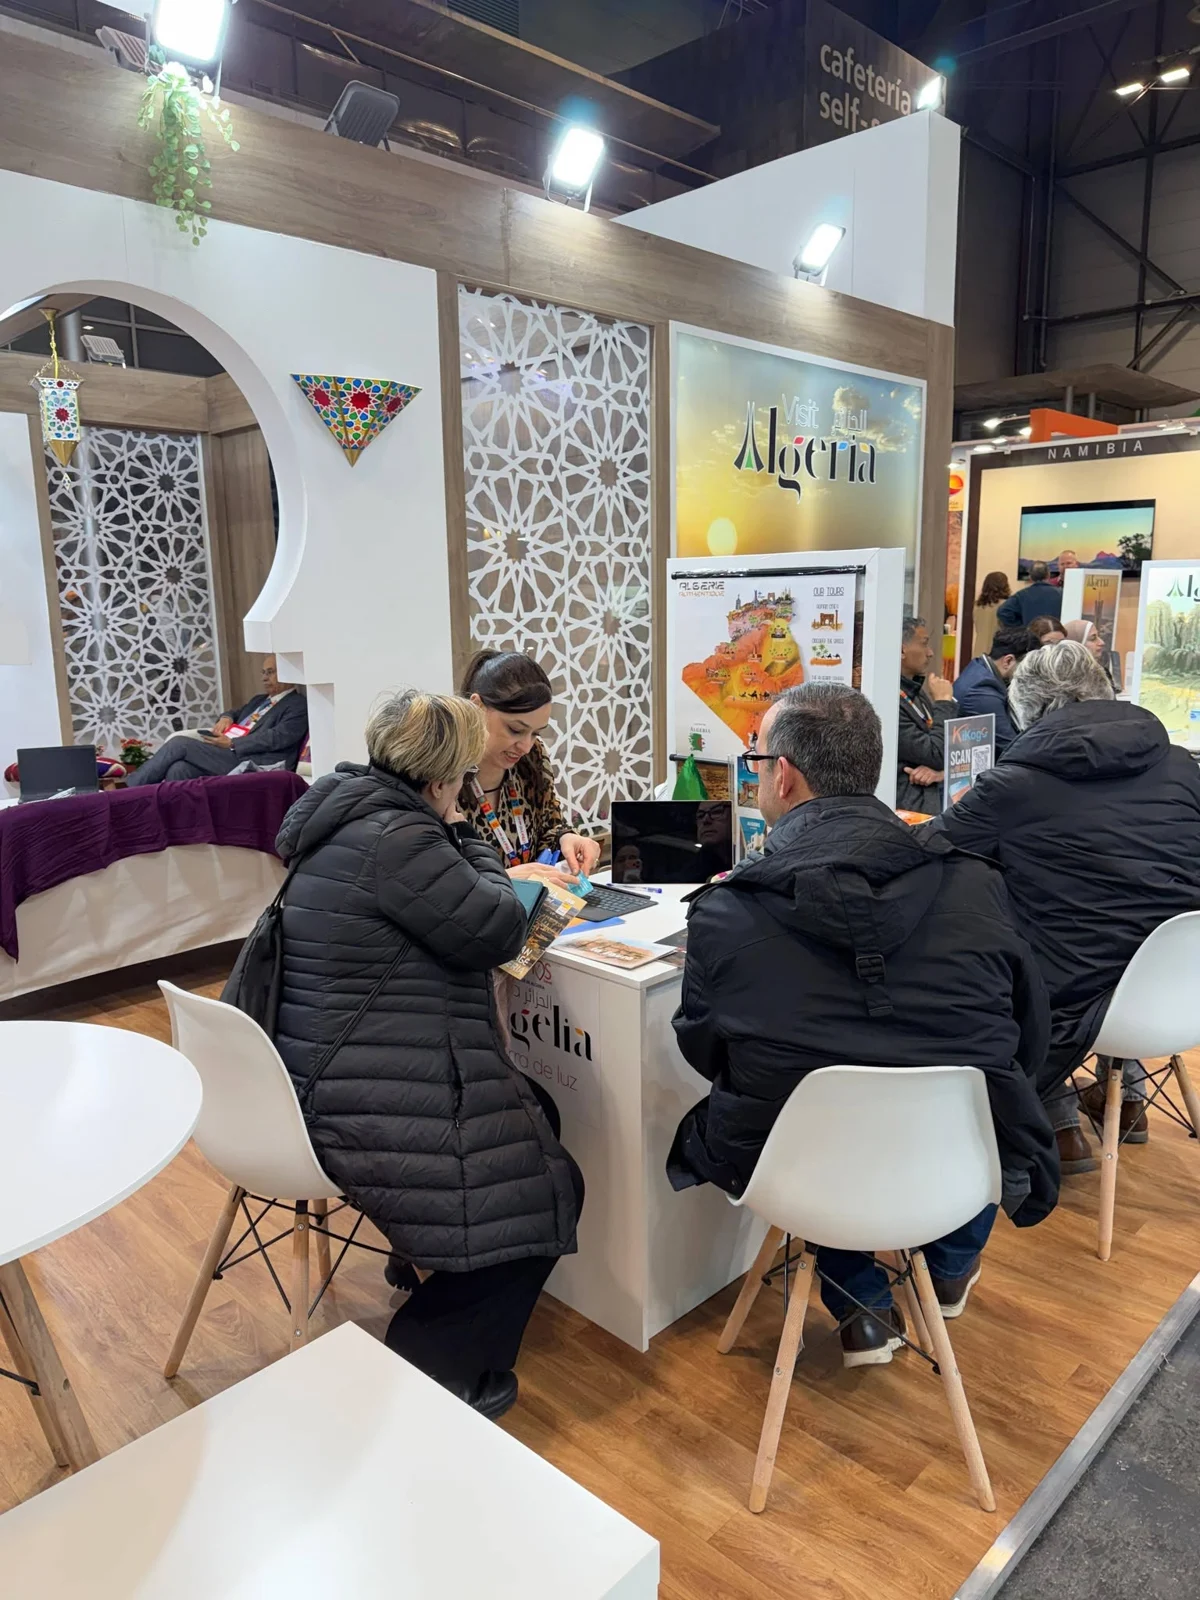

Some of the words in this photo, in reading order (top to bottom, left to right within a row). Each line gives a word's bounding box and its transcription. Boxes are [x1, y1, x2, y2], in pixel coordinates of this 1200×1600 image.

[820, 44, 911, 116] cafetería
[782, 393, 819, 428] Visit
[733, 400, 876, 505] Algeria
[1047, 440, 1143, 460] NAMIBIA
[826, 586, 845, 597] TOURS
[950, 748, 971, 766] SCAN
[510, 1004, 593, 1062] gelia
[532, 1058, 553, 1080] de
[556, 1064, 578, 1092] luz
